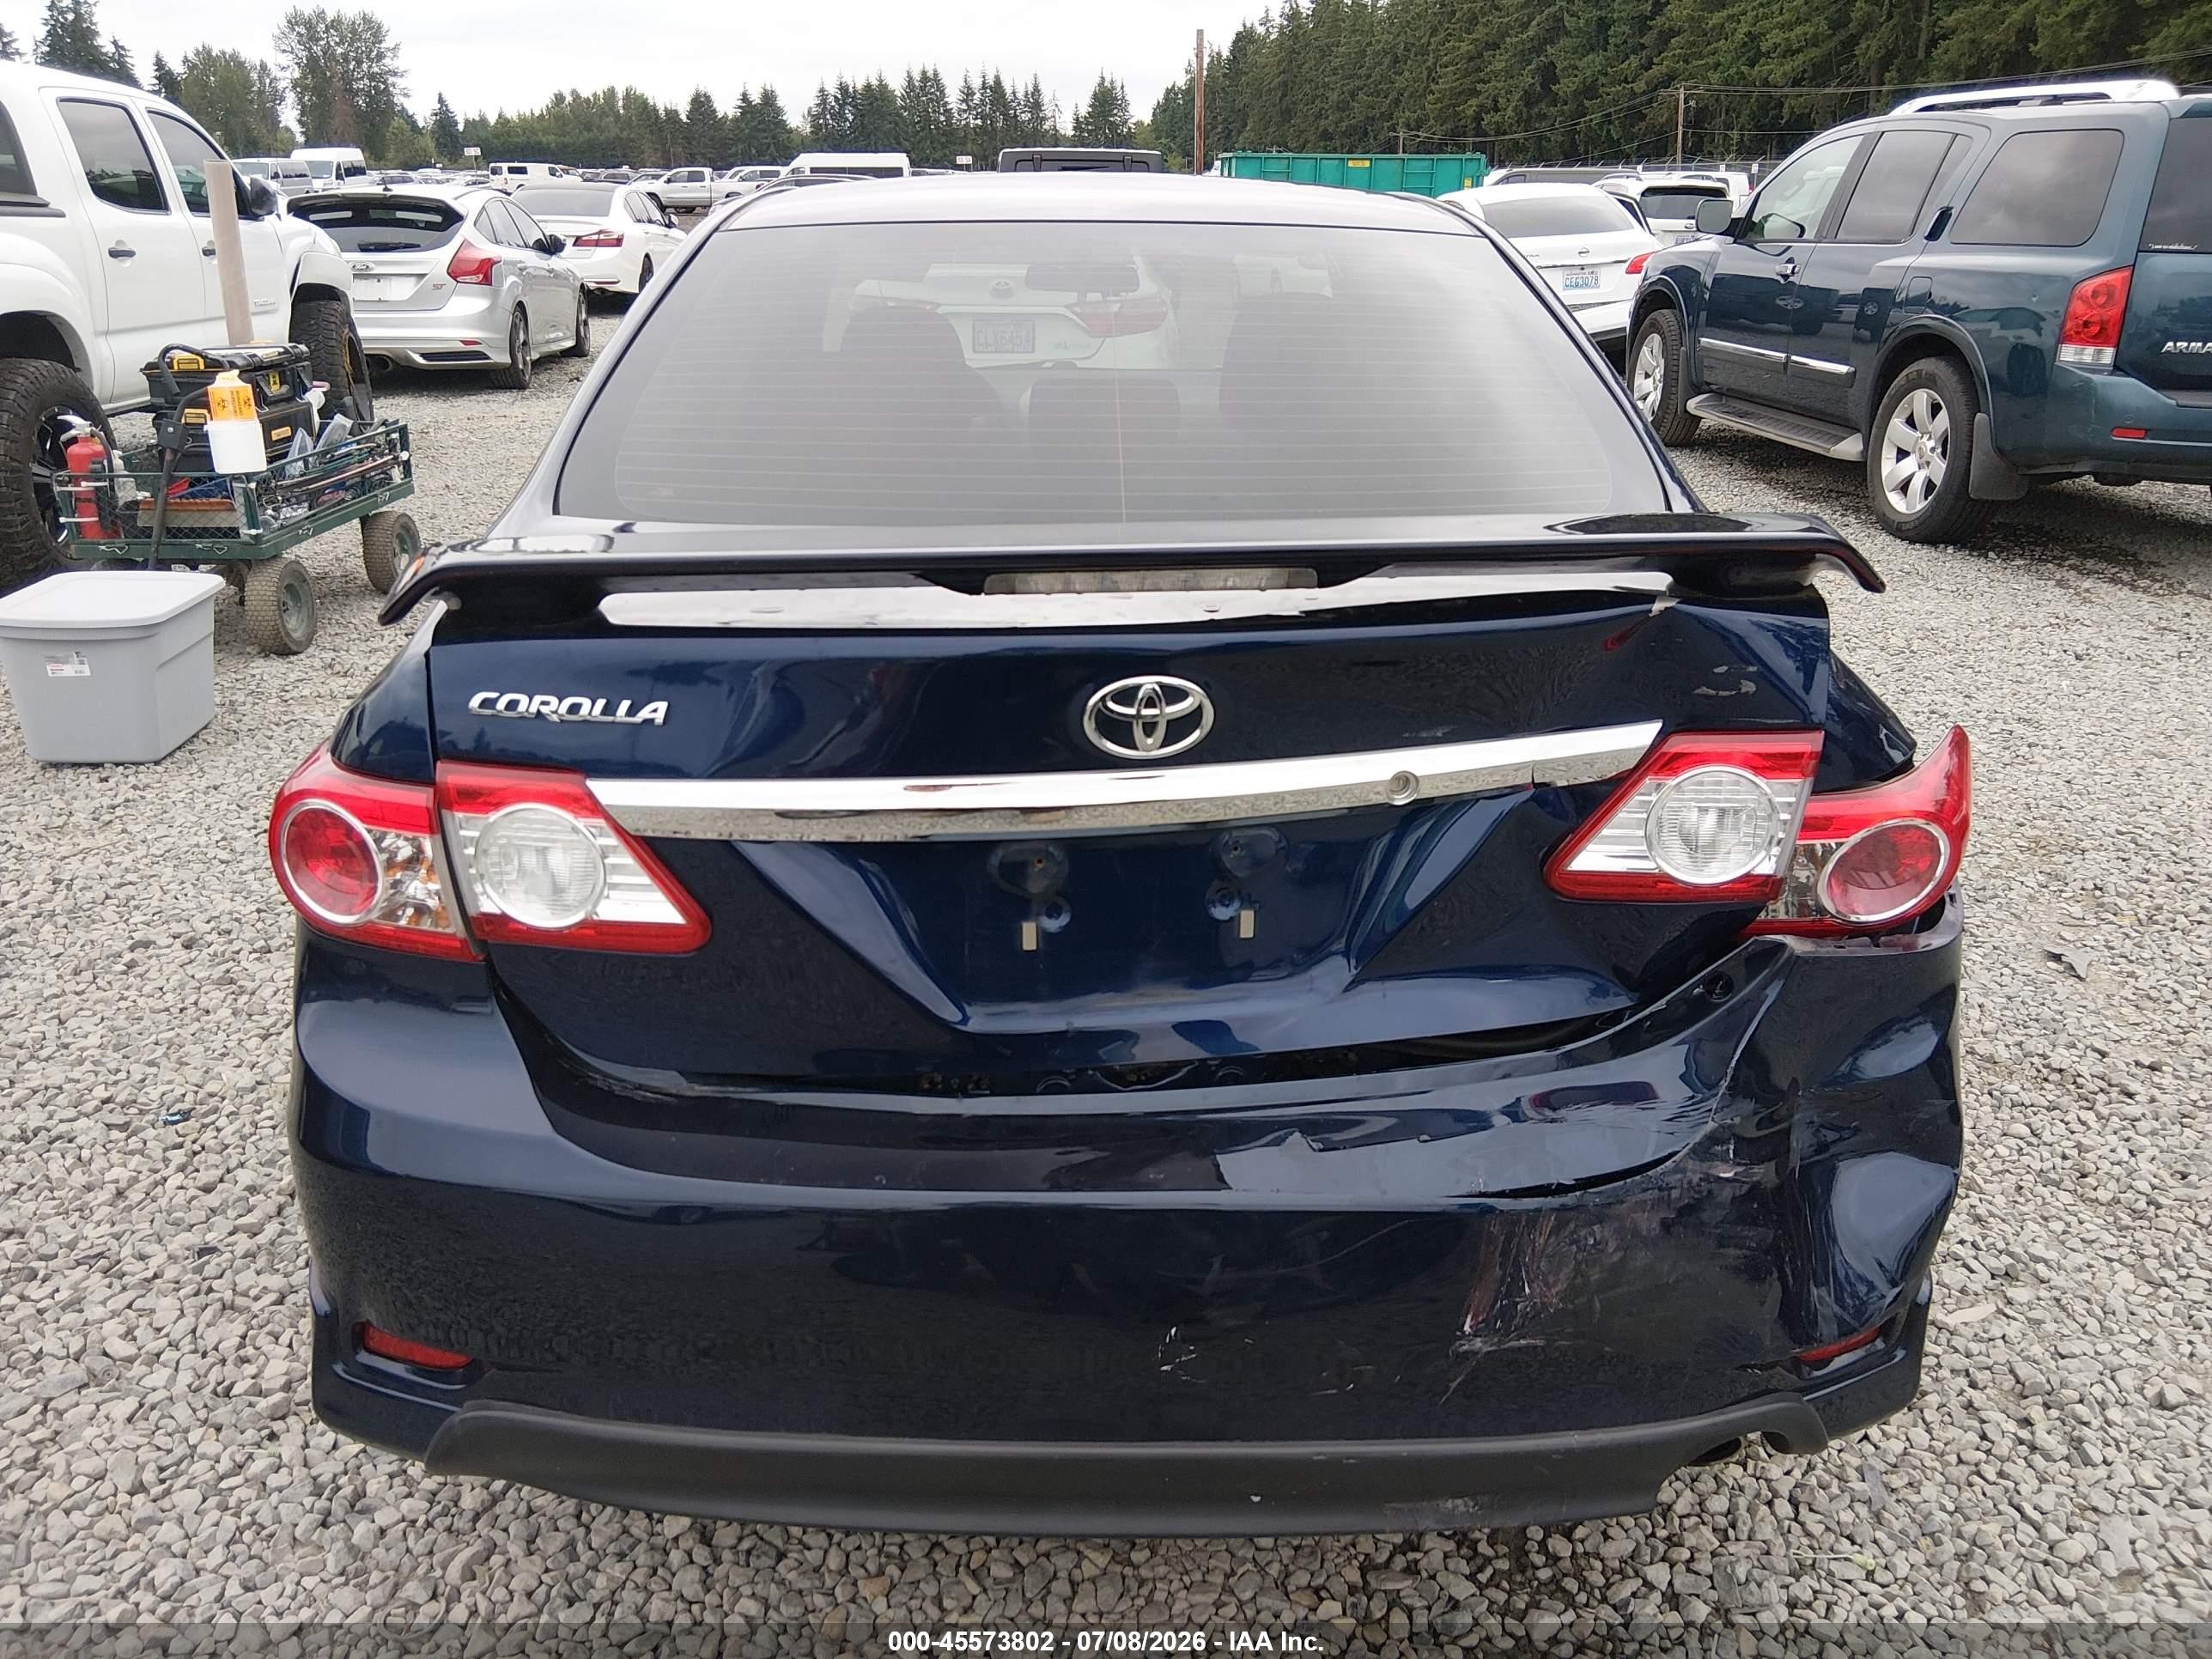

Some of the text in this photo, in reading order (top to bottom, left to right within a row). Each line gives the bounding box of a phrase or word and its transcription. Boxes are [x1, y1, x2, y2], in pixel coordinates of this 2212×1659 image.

[1565, 275, 1599, 288] CEG3078
[2160, 341, 2212, 354] ARMA
[469, 691, 669, 726] COROLLA
